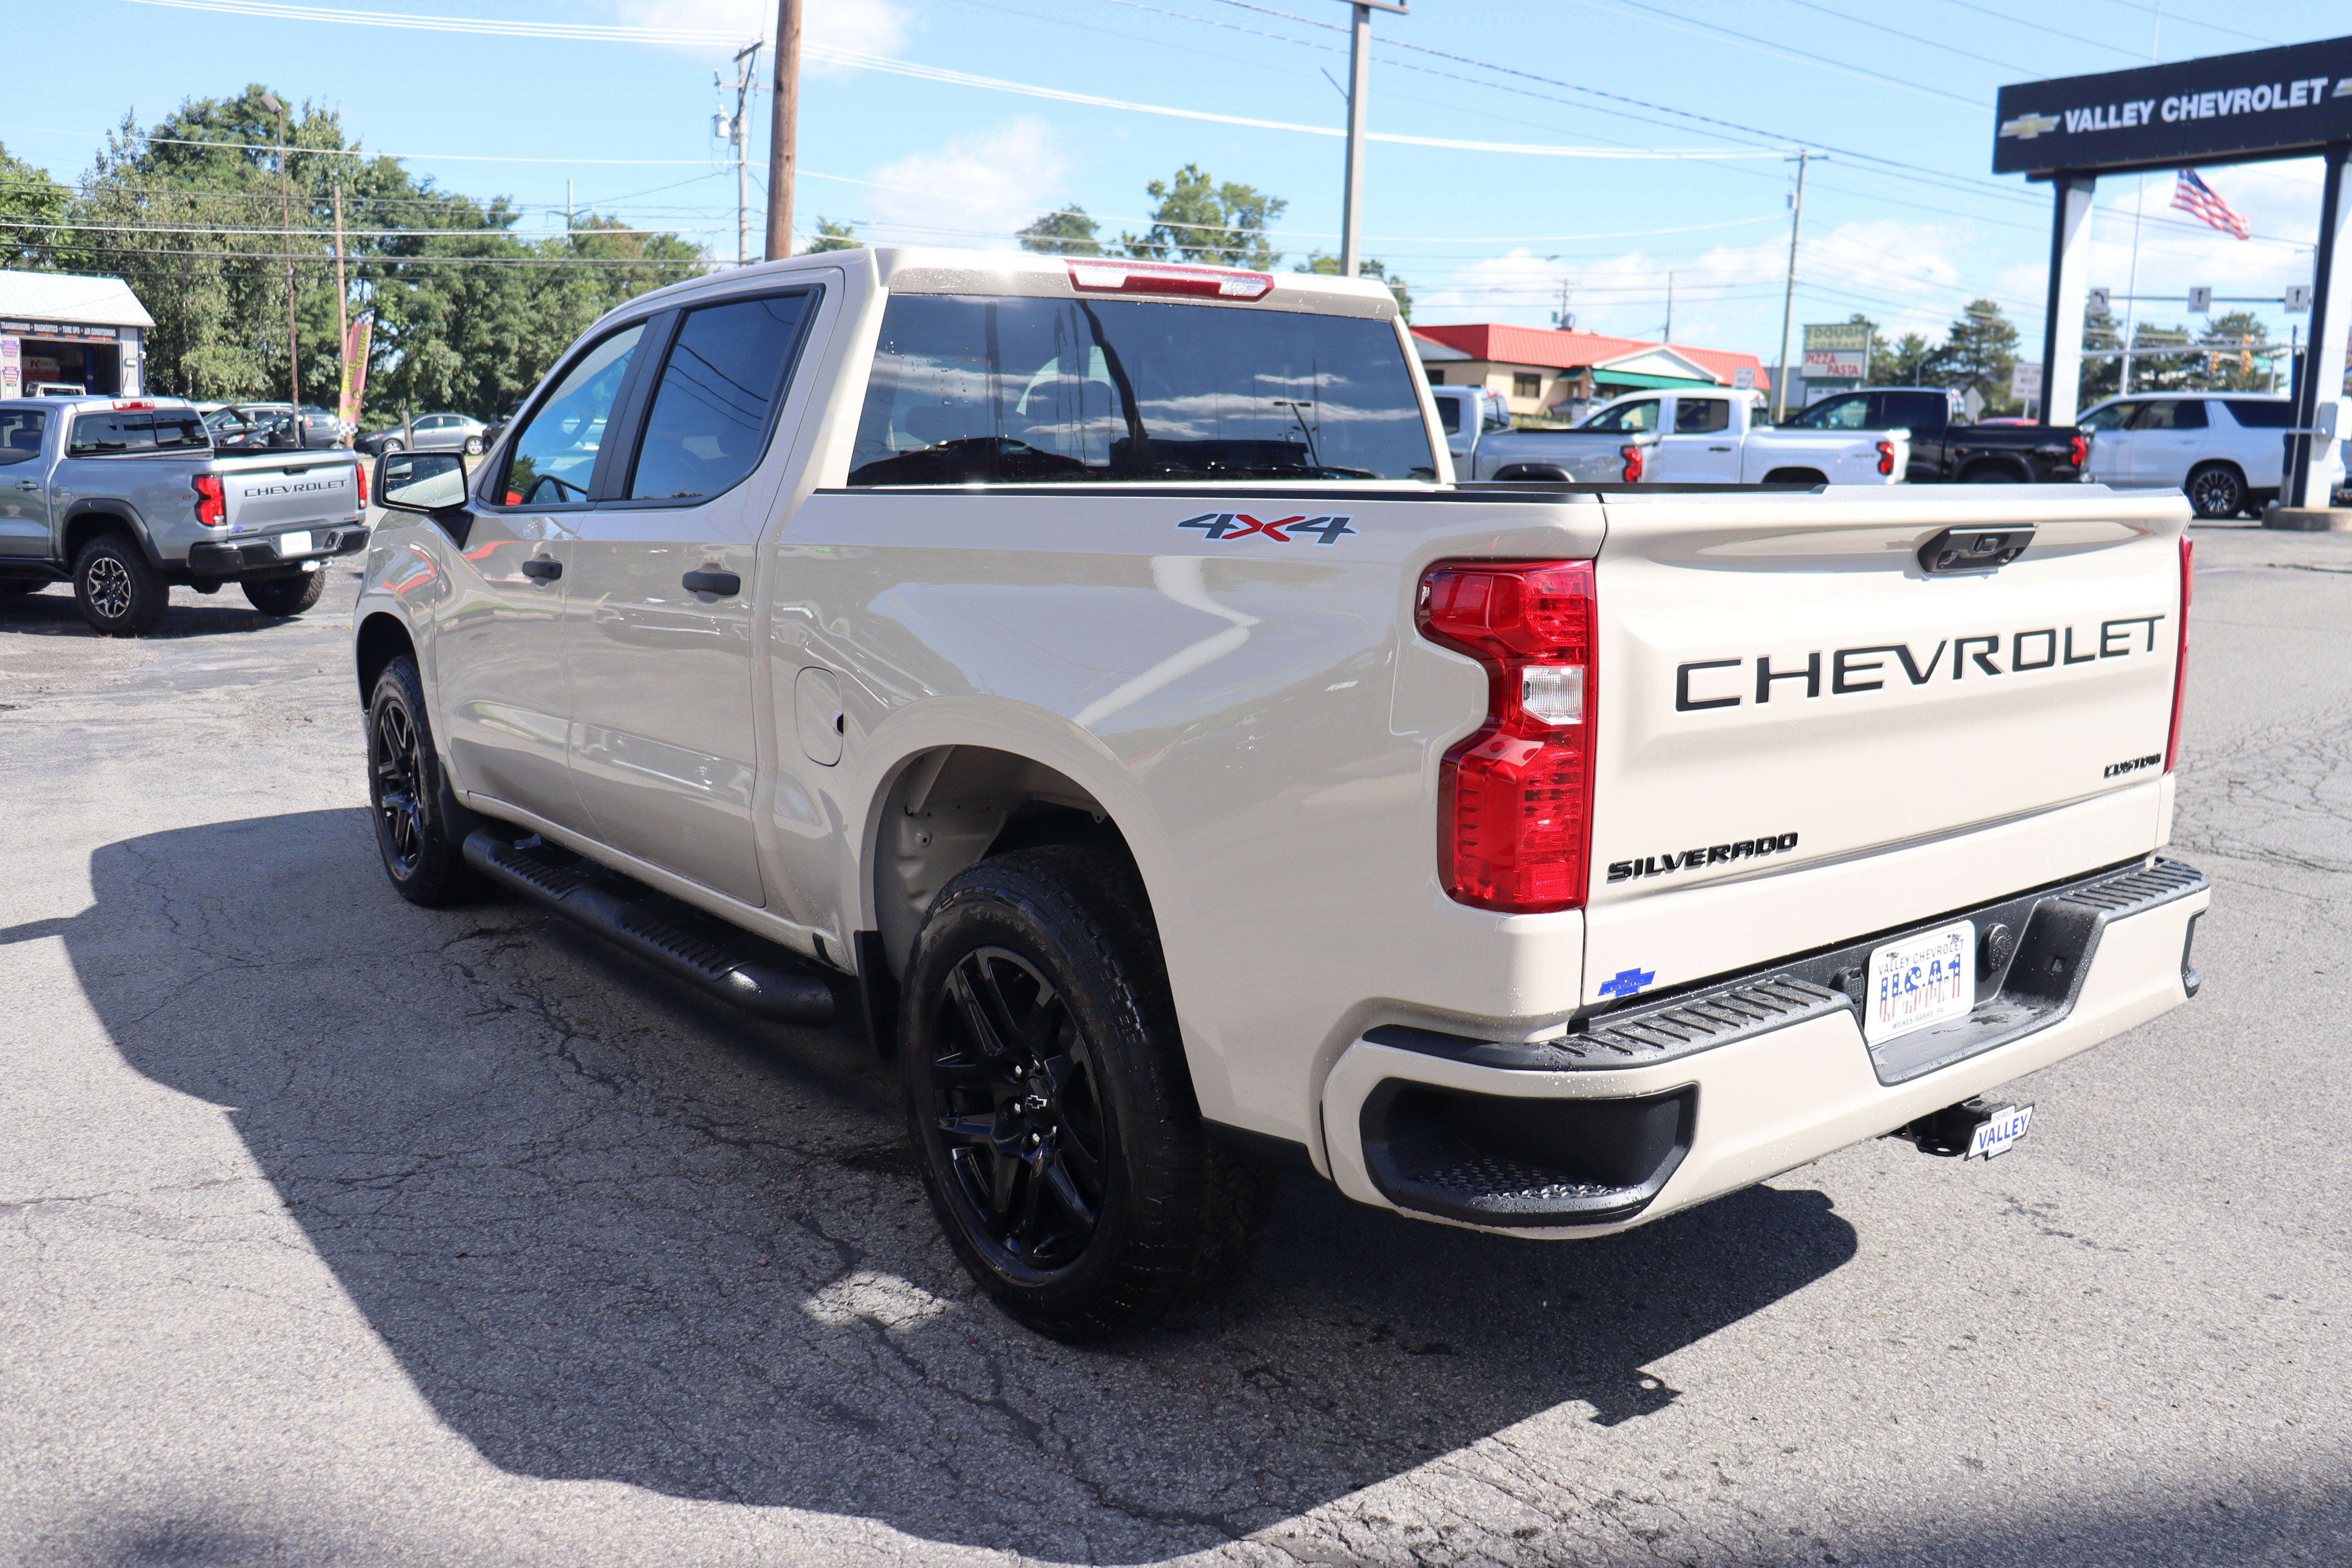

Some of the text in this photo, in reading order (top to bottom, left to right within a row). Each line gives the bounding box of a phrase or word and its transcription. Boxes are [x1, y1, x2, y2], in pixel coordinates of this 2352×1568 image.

[2065, 77, 2329, 134] VALLEY CHEVROLET
[1, 321, 30, 331] TRANSMISSIONS
[34, 323, 58, 333] DIAGNOSTICS
[62, 325, 72, 334] TUNE
[91, 328, 116, 337] CONDITIONING
[355, 327, 368, 369] SERVICE
[1805, 354, 1835, 364] PIZZA
[341, 360, 356, 394] BRAKE
[1827, 364, 1859, 375] PASTA
[245, 480, 348, 497] CHEVROLET
[1675, 615, 2165, 712] CHEVROLET
[2104, 752, 2161, 779] CUSTOM
[1607, 832, 1798, 880] SILVERADO
[1879, 939, 1964, 976] VALLEY CHEVROLET
[1937, 1007, 1944, 1015] PA
[1993, 1109, 2013, 1122] CHEVROLET
[1979, 1114, 2028, 1149] VALLEY
